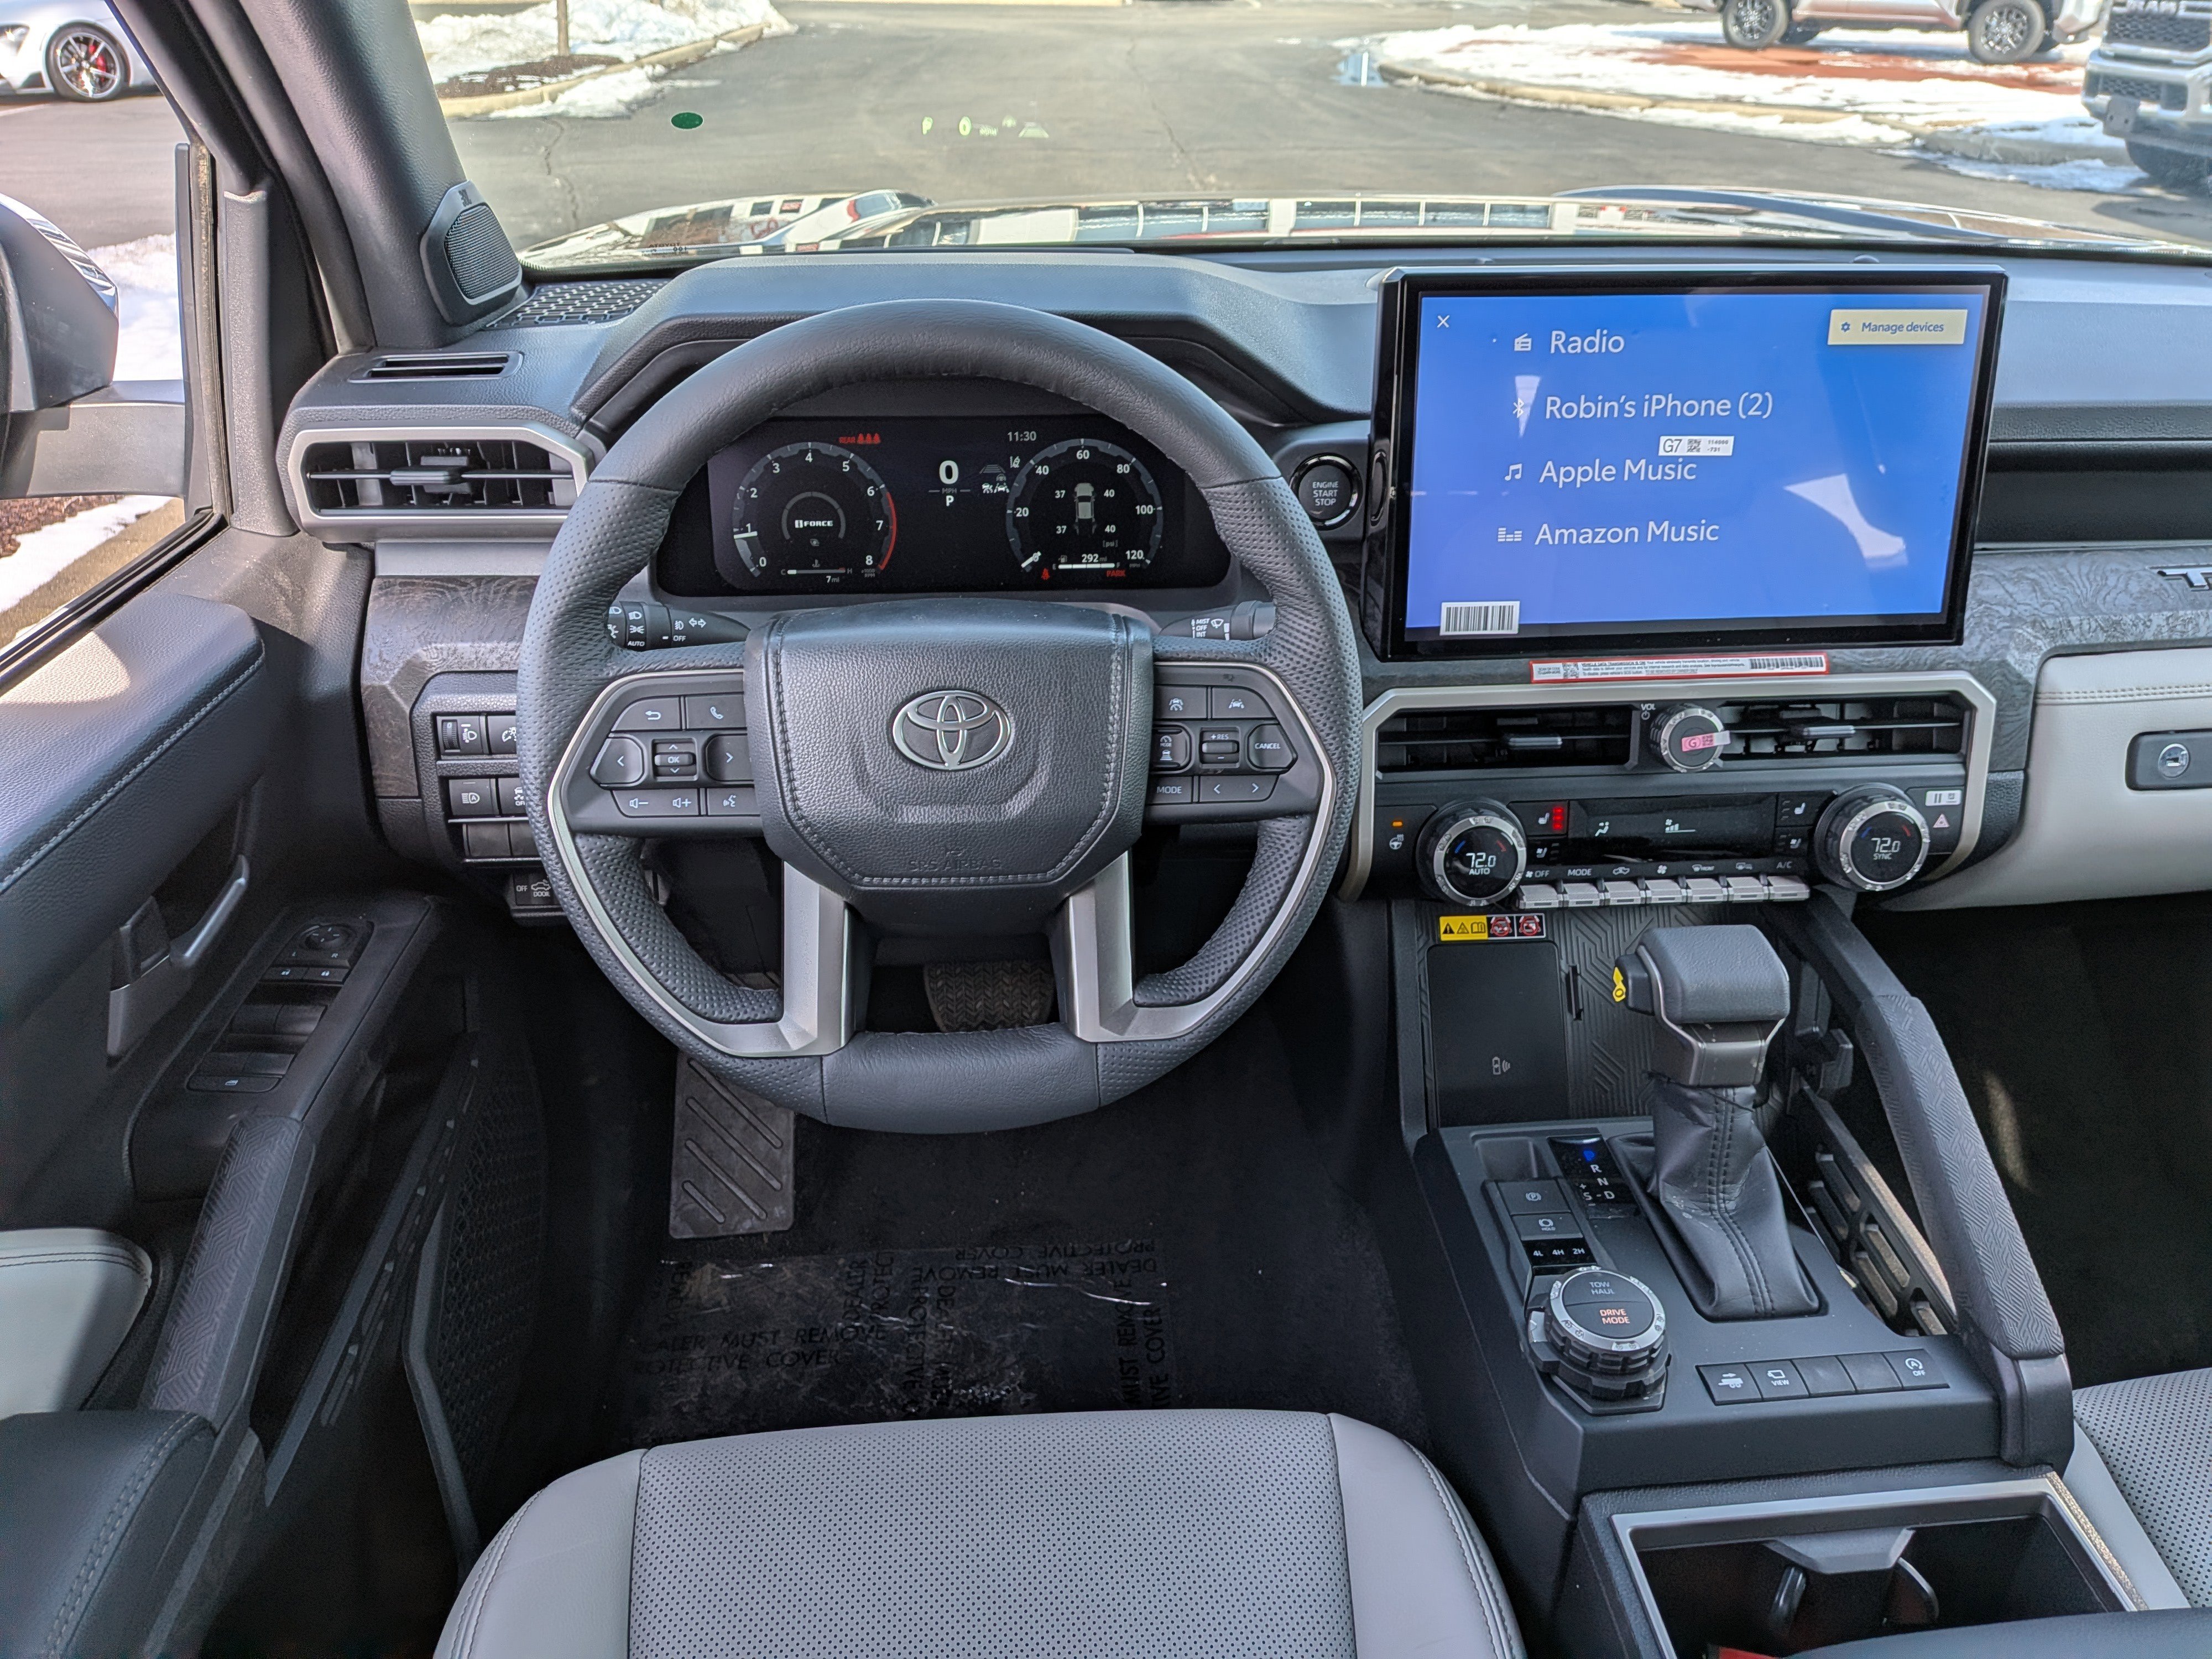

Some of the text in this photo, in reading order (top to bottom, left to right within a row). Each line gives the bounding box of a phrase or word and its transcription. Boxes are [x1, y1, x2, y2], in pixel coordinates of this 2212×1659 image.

[1861, 321, 1944, 334] Manage devices
[1550, 329, 1625, 354] Radio
[1642, 393, 1731, 418] iPhone
[1738, 392, 1774, 419] (2)
[1008, 431, 1037, 441] 11:30
[1663, 439, 1682, 453] G7
[805, 452, 813, 463] 4
[1076, 450, 1090, 460] 60
[773, 462, 780, 473] 3
[842, 460, 850, 472] 5
[1035, 465, 1050, 476] 40
[1117, 464, 1130, 474] 80
[939, 460, 959, 485] 0
[1540, 457, 1697, 488] Apple Music
[750, 488, 758, 498] 2
[867, 486, 875, 497] 6
[1055, 490, 1066, 499] 37
[1104, 489, 1115, 498] 40
[1313, 489, 1338, 498] START
[946, 495, 954, 507] P
[1015, 507, 1030, 517] 20
[1135, 504, 1154, 515] 100
[746, 523, 752, 533] 1
[876, 520, 884, 531] 7
[1056, 525, 1067, 534] 37
[1105, 525, 1116, 533] 40
[1535, 519, 1720, 546] Amazon Music
[865, 555, 873, 565] 8
[1082, 554, 1099, 563] 292
[1125, 550, 1144, 560] 120
[759, 557, 767, 567] 0
[1156, 786, 1182, 794] MODE
[1466, 853, 1496, 868] 72.0
[1777, 861, 1793, 869] A/C
[1590, 1164, 1603, 1173] R
[1597, 1177, 1609, 1186] N
[1583, 1191, 1615, 1201] S D
[1600, 1308, 1627, 1317] DRIVE
[1602, 1316, 1630, 1324] MODE
